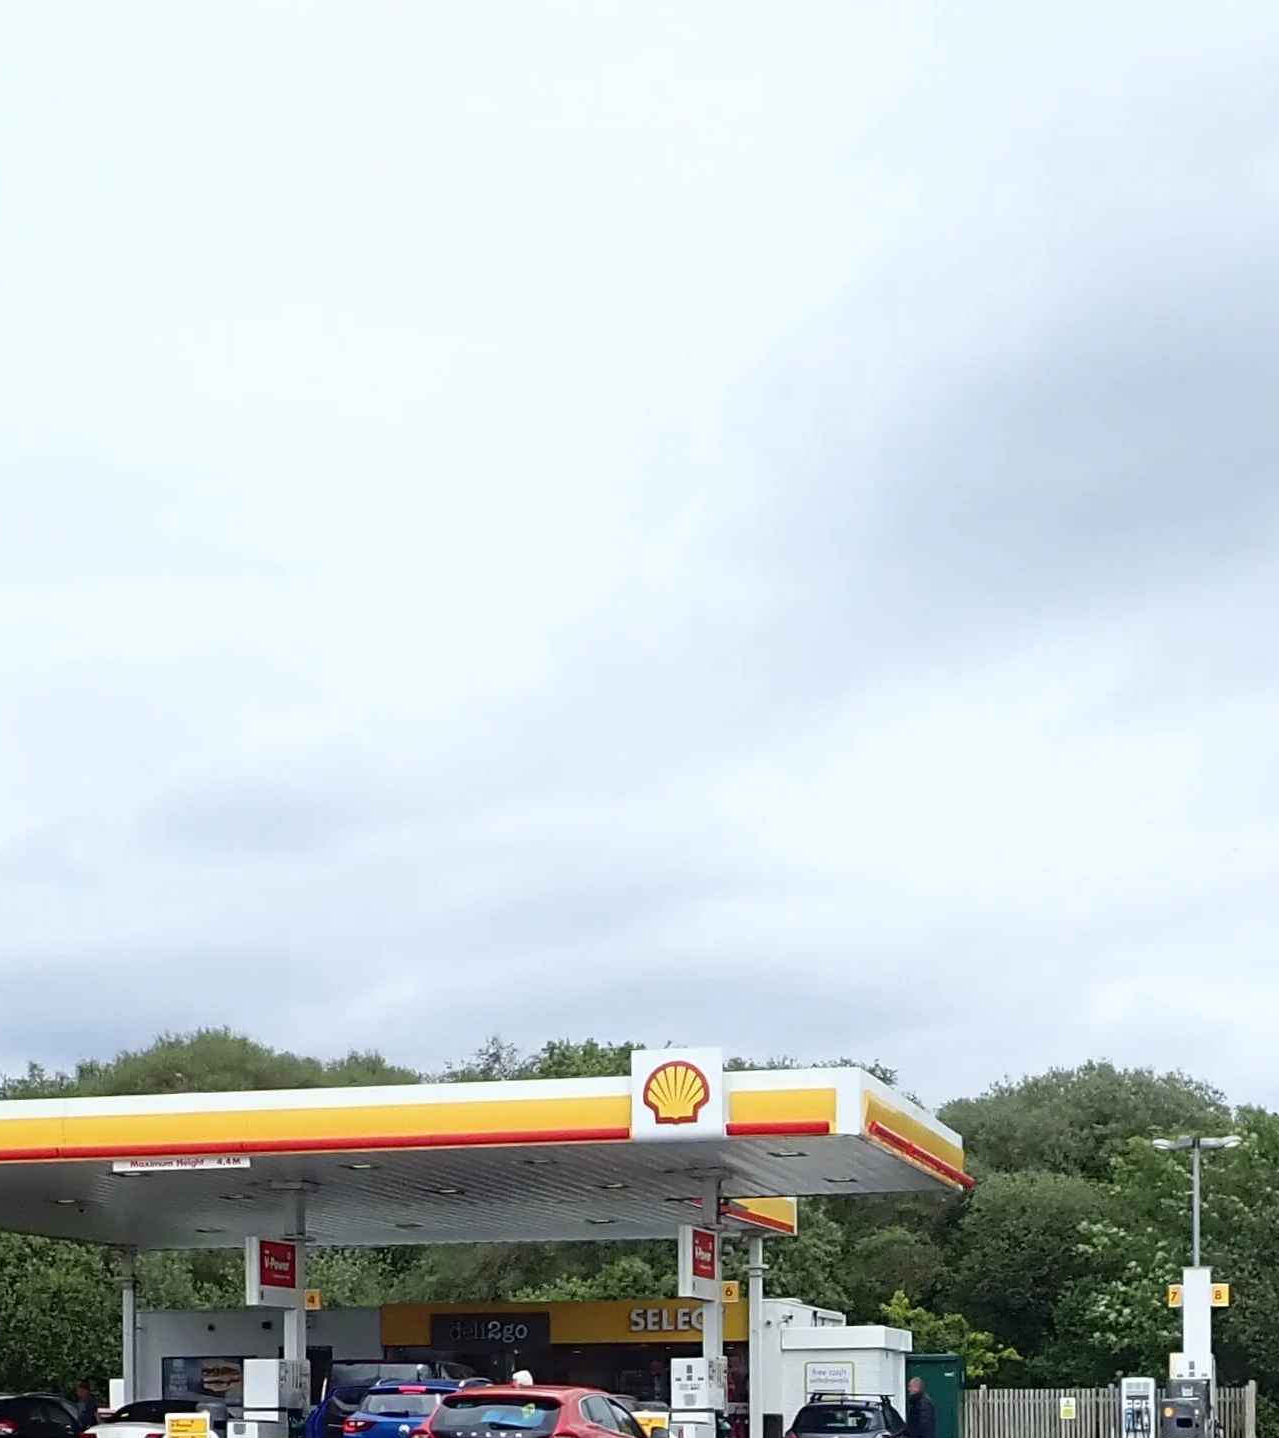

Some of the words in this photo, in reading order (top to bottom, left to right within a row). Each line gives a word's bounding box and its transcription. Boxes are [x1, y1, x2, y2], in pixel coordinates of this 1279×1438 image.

[130, 1160, 173, 1168] Maximum
[177, 1158, 204, 1167] Height
[725, 1287, 733, 1296] 6
[1171, 1291, 1178, 1302] 7
[1215, 1290, 1222, 1300] 8
[308, 1295, 315, 1304] 4
[630, 1308, 704, 1332] SELEC
[449, 1320, 528, 1343] deli2go
